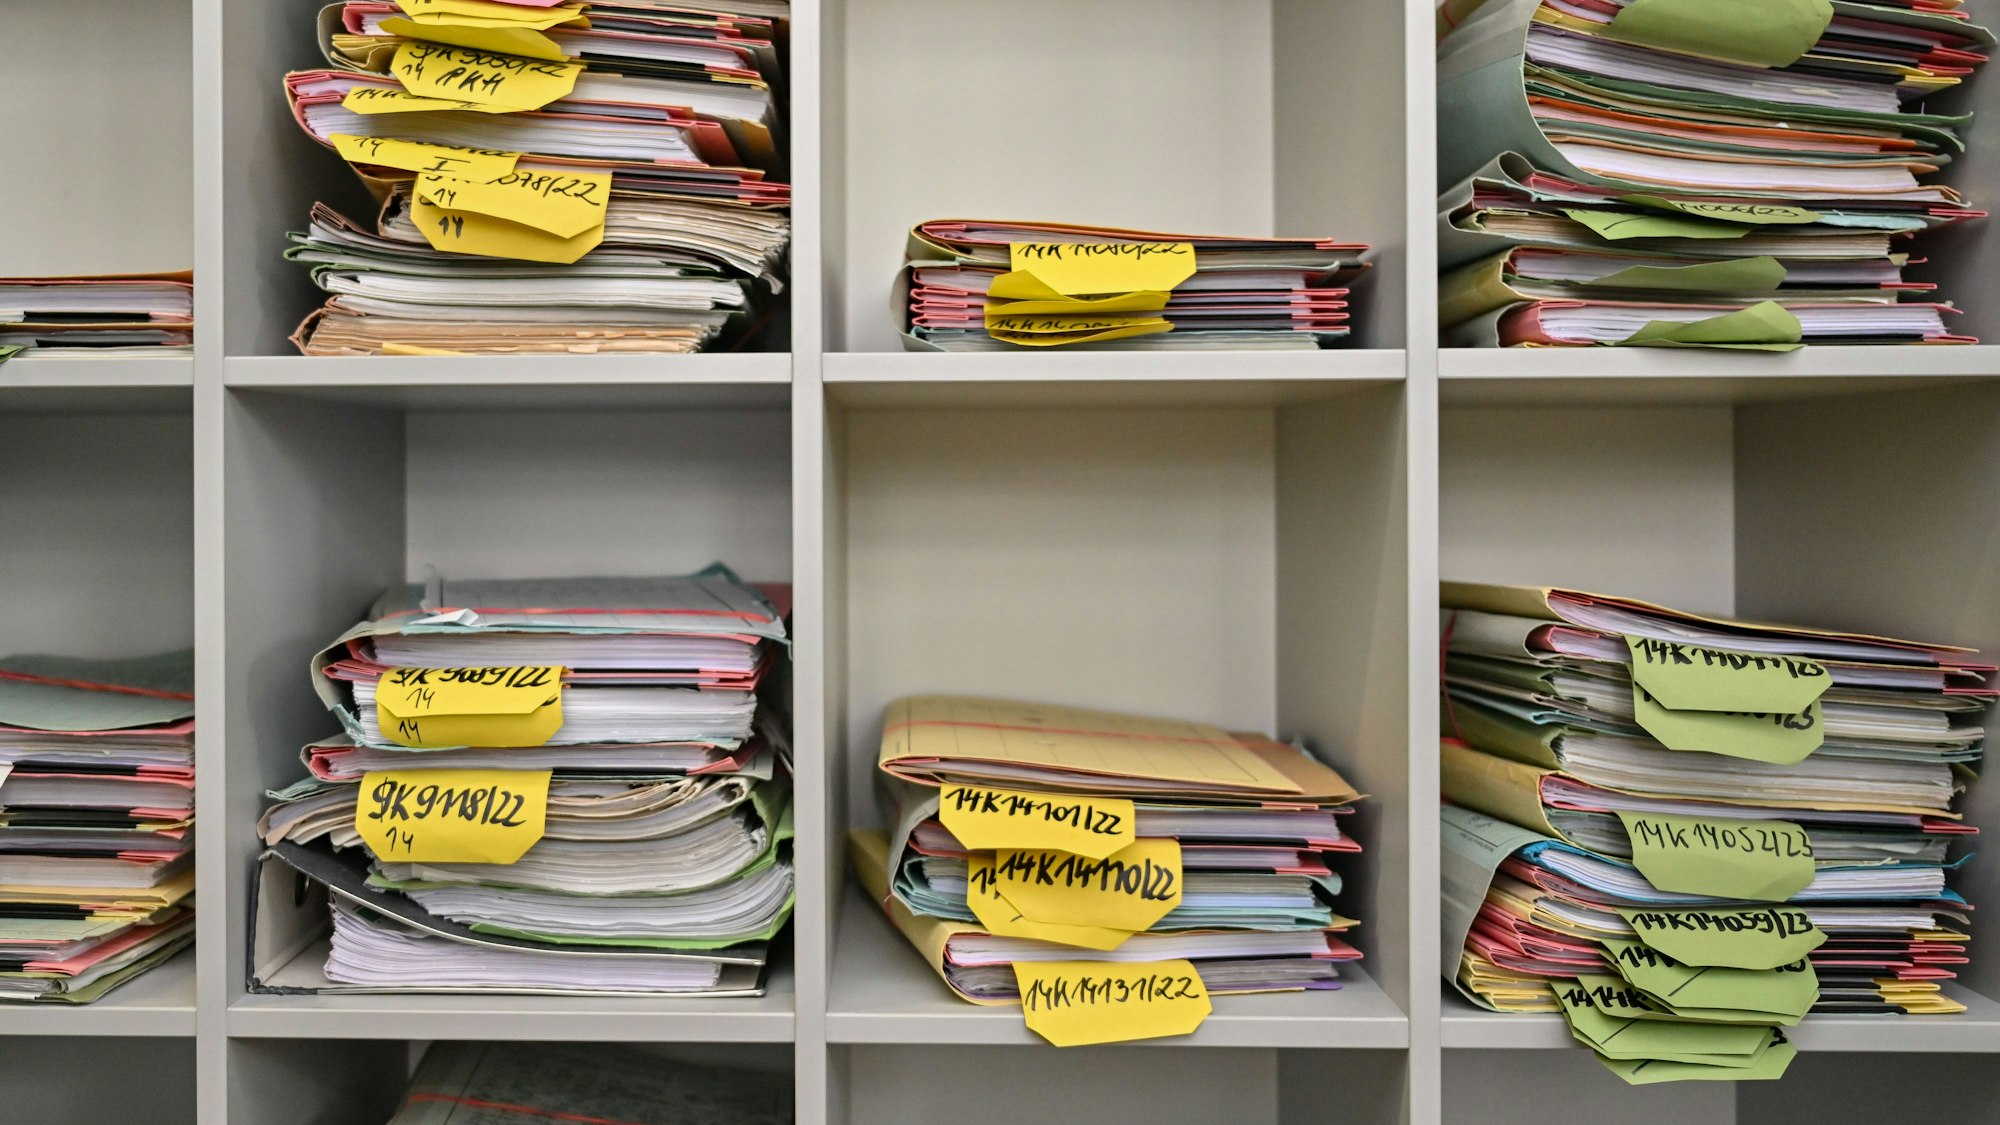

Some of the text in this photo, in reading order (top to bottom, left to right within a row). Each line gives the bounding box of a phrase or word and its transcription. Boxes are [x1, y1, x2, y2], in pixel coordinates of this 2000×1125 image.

[434, 188, 457, 207] 14
[438, 215, 464, 239] 14
[406, 688, 436, 709] 14
[399, 719, 422, 743] 14
[386, 826, 414, 854] 14
